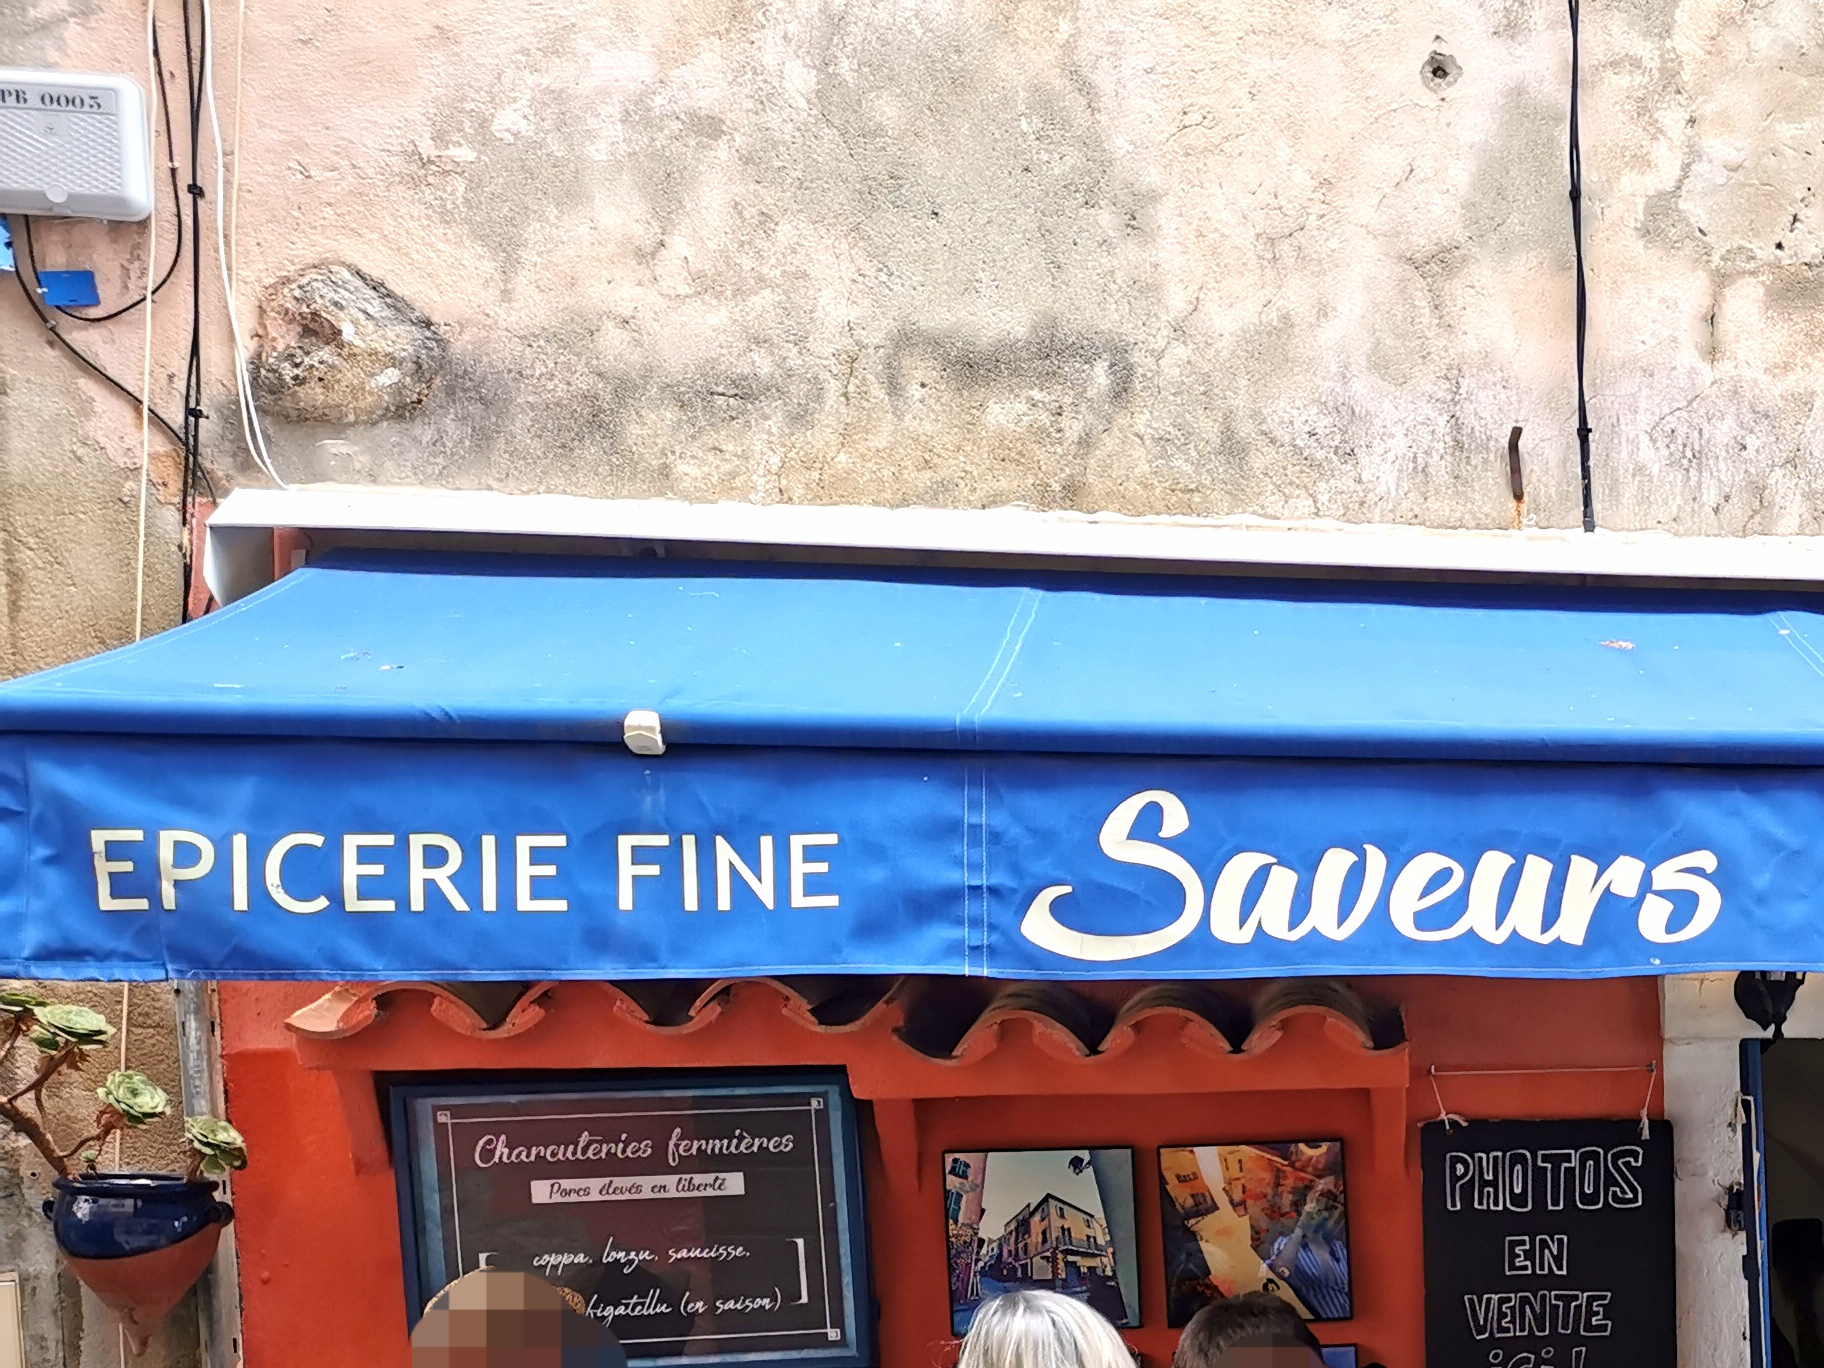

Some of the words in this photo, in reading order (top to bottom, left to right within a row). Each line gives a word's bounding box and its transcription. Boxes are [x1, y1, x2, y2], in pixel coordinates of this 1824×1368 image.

[89, 829, 569, 913] EPICERIE
[615, 832, 841, 911] FINE
[1019, 789, 1722, 962] Saveurs
[473, 1130, 653, 1168] Charcuteries
[667, 1127, 795, 1167] fermières
[550, 1181, 591, 1199] Porcs
[599, 1178, 643, 1197] élevés
[651, 1182, 670, 1193] en
[676, 1175, 727, 1193] liberté
[1445, 1146, 1643, 1211] PHOTOS
[1504, 1235, 1568, 1275] EN
[680, 1291, 708, 1317] (en
[714, 1287, 782, 1315] saison)
[1464, 1291, 1613, 1339] VENTE
